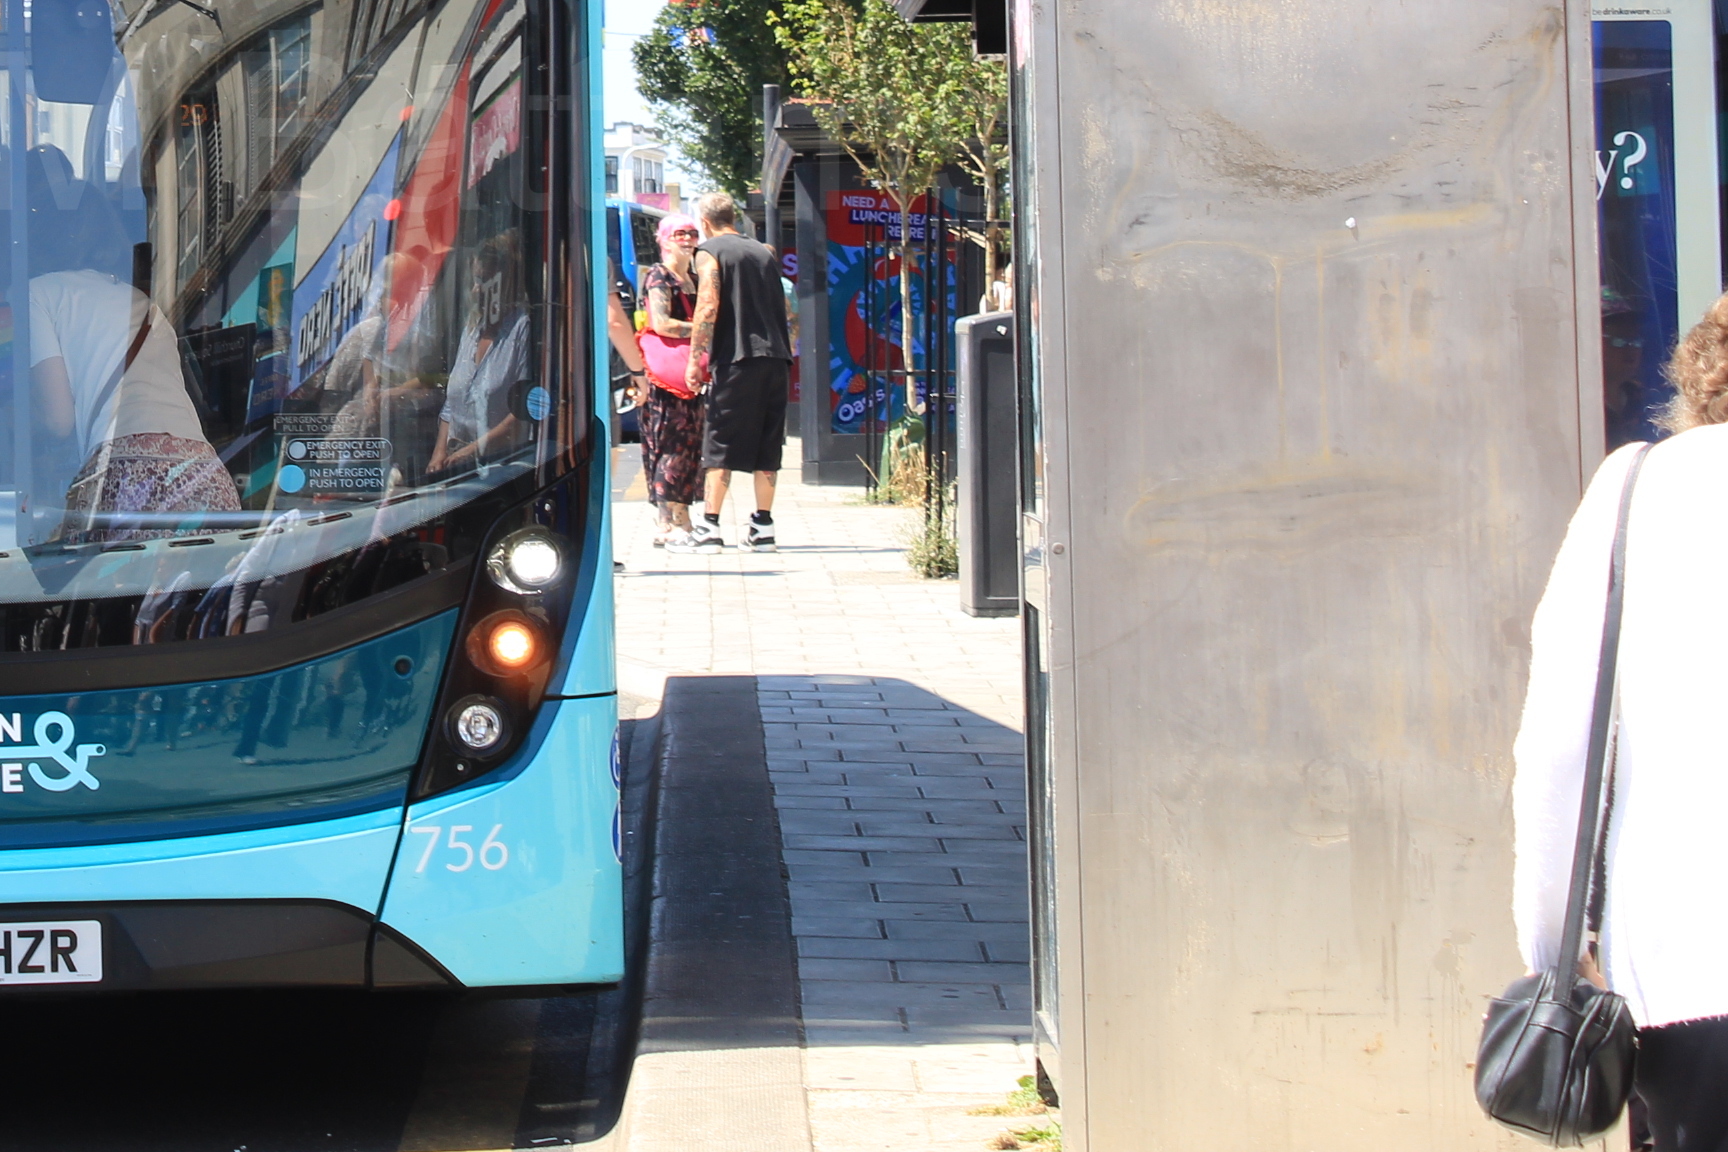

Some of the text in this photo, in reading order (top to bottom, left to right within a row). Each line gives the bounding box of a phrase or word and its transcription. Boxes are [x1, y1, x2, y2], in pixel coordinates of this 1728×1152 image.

[842, 195, 890, 209] NEED A
[276, 415, 328, 424] EMERGENCY
[283, 424, 345, 433] PULL TO OPEN
[306, 440, 387, 450] EMERGENCY EXIT
[309, 450, 380, 459] PUSH TO OPEN
[309, 468, 386, 477] IN EMERGENCY
[309, 478, 385, 488] PUSH TO OPEN
[409, 823, 509, 873] 756
